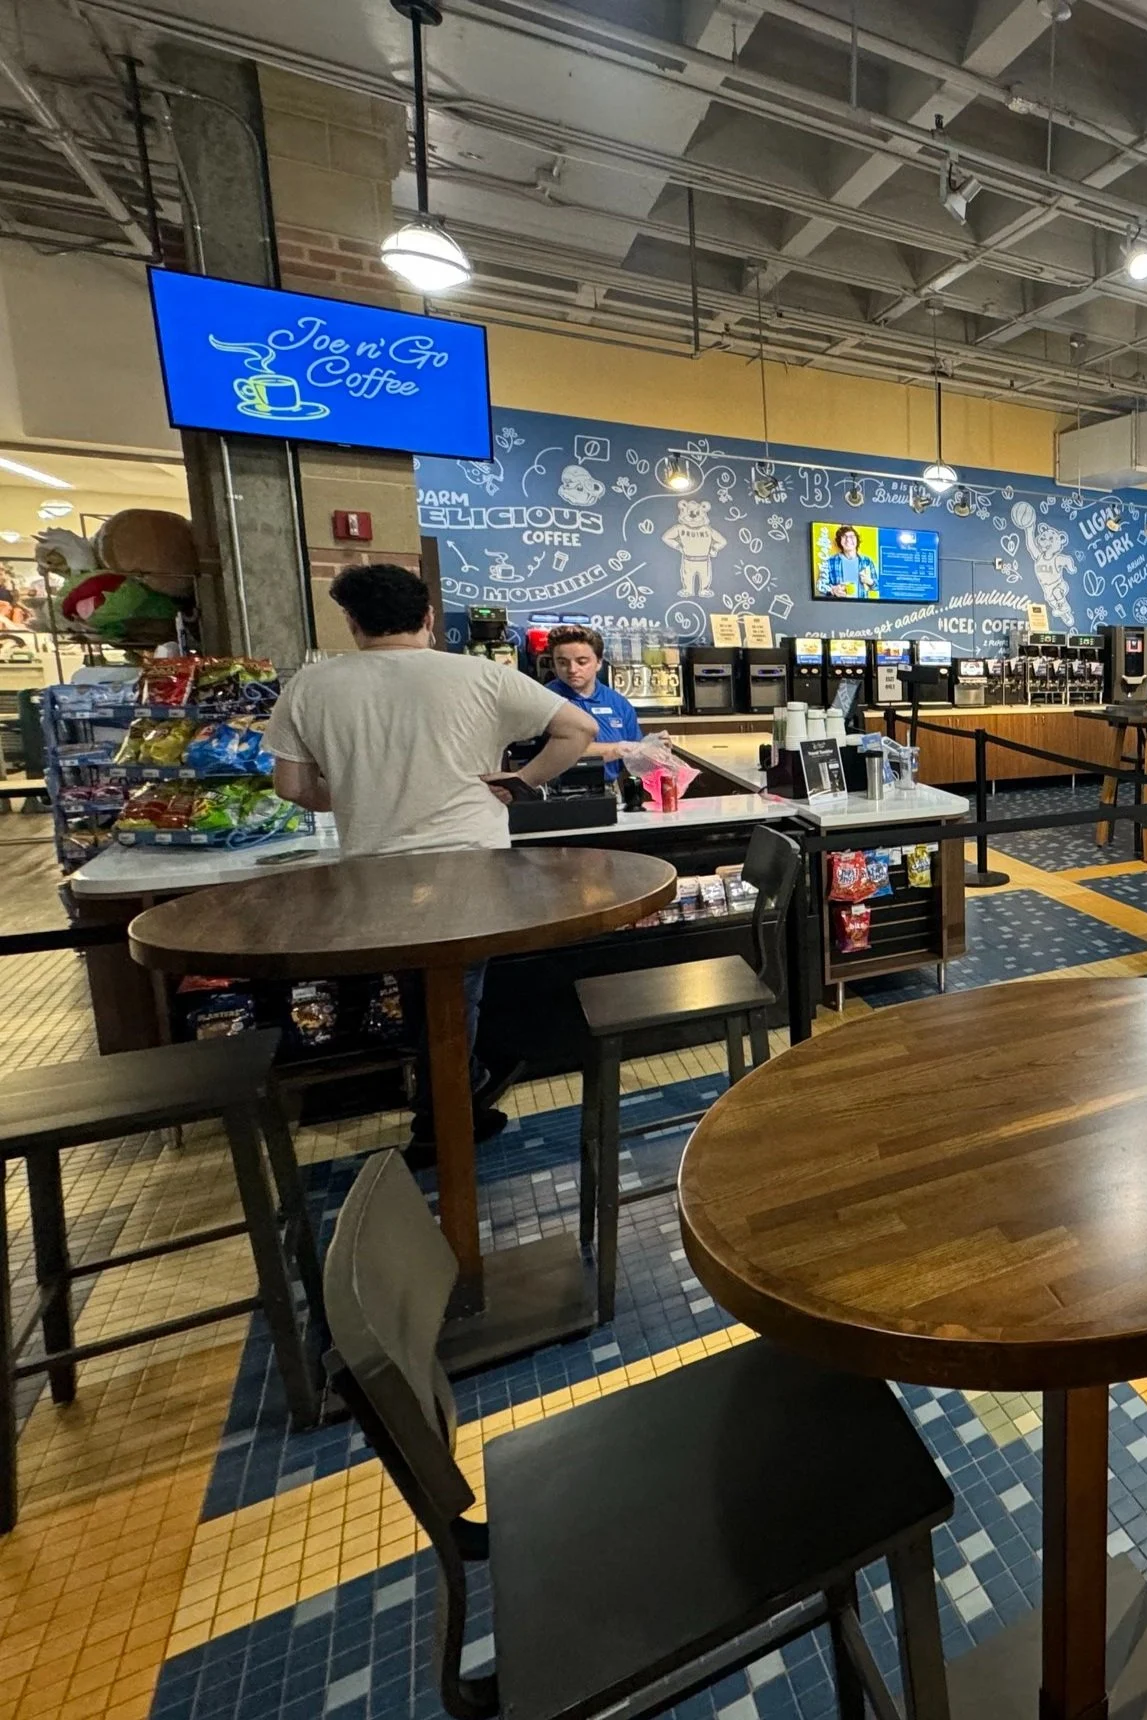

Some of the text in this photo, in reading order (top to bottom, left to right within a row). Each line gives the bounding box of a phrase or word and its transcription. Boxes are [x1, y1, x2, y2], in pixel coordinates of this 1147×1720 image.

[267, 316, 349, 356] Joe
[389, 336, 449, 370] Go
[306, 356, 420, 399] Coffee
[773, 493, 788, 503] UP
[417, 505, 604, 534] ELICIOUS
[522, 530, 582, 547] COFFEE
[681, 530, 710, 538] BRUINS
[1094, 533, 1134, 568] DARK
[1126, 554, 1146, 573] BRUIN
[440, 564, 608, 603] OD MORNING
[839, 627, 873, 638] please
[874, 620, 894, 638] get
